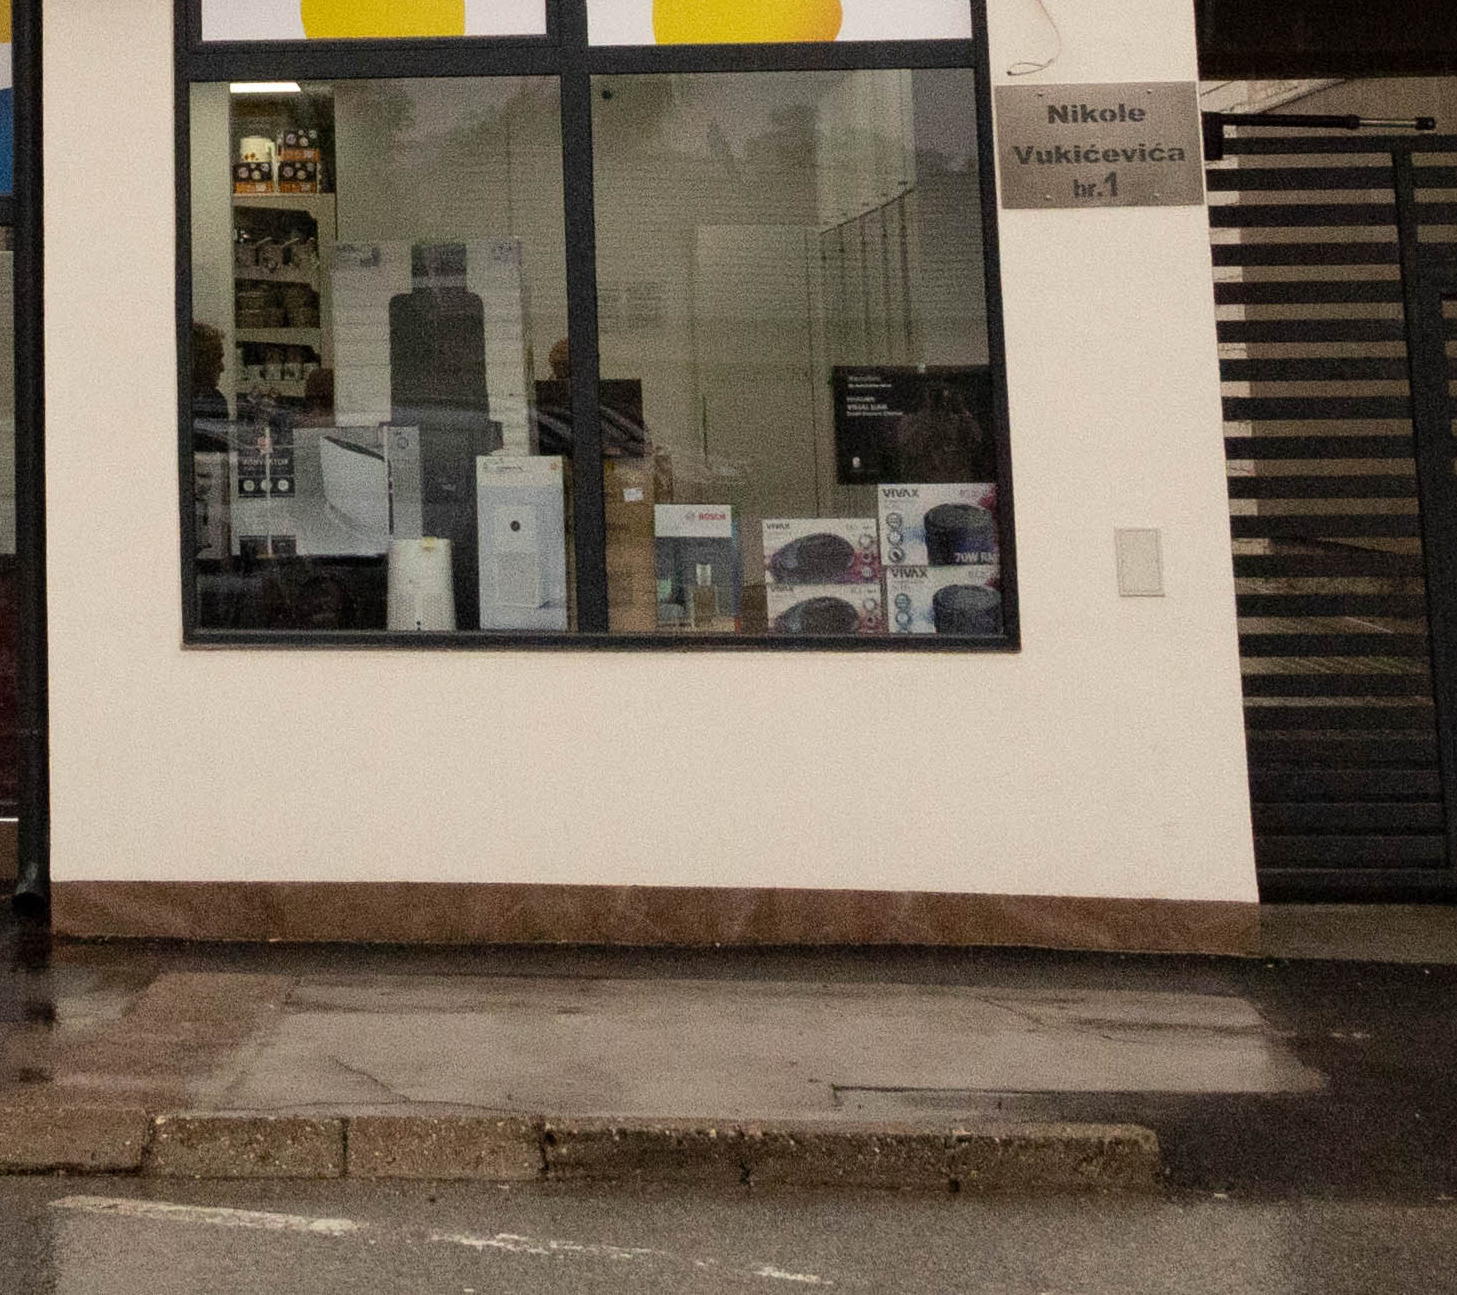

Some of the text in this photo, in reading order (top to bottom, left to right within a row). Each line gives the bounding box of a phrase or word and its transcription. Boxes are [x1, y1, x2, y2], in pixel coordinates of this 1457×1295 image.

[1047, 103, 1146, 125] Nikole
[1012, 142, 1186, 165] Vukićevića
[883, 488, 919, 497] VIVAX
[891, 567, 928, 578] VIVAX
